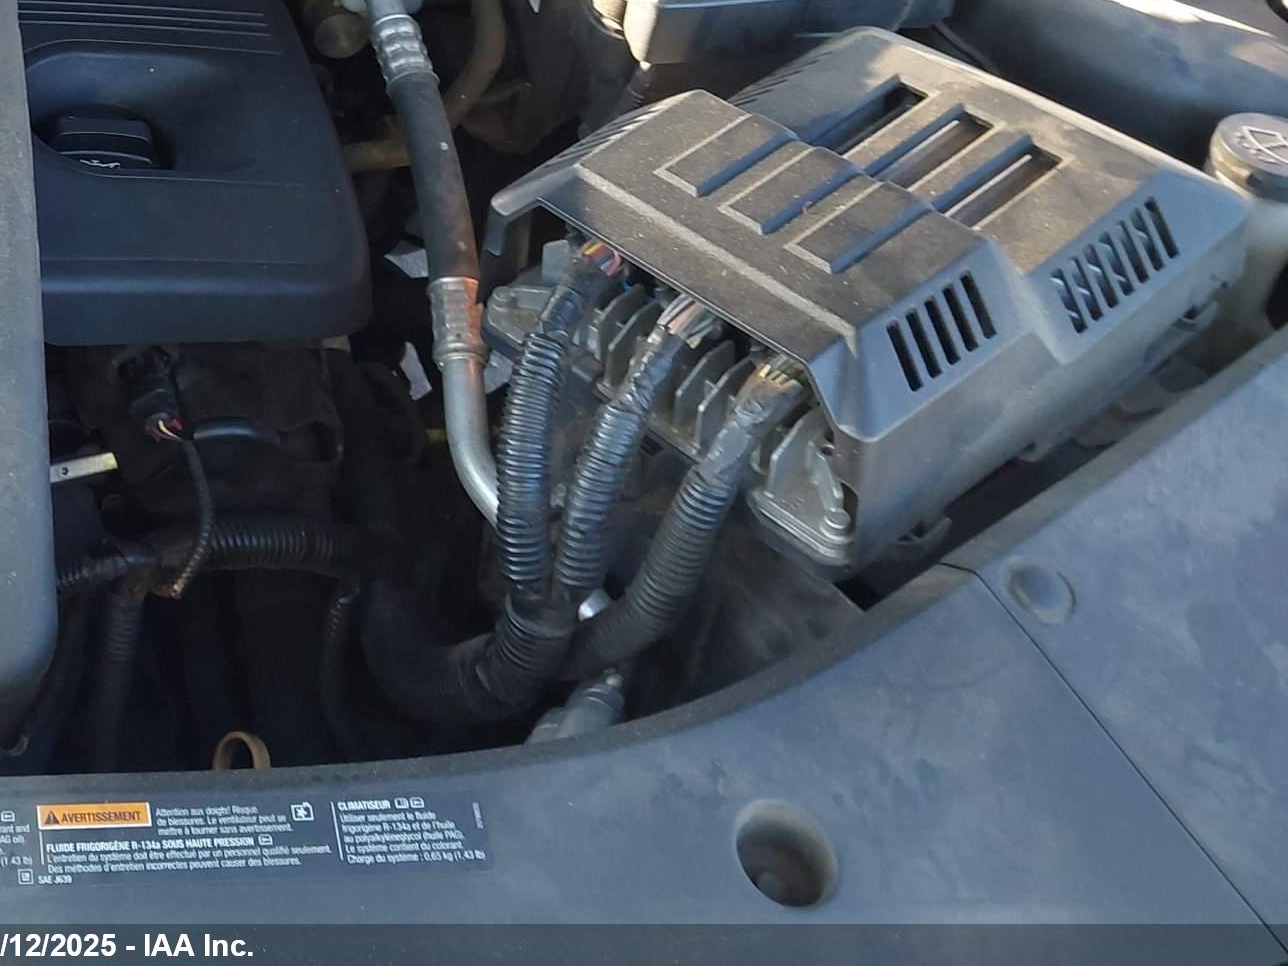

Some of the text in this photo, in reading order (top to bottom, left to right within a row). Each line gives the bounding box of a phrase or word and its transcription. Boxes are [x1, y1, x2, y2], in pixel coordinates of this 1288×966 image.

[337, 799, 391, 811] CLIMATISEUR
[62, 810, 141, 823] AVERTISSEMENT
[156, 817, 167, 827] de
[15, 824, 30, 833] and
[46, 842, 75, 854] FLUIDE
[131, 840, 161, 851] R-134a
[162, 839, 184, 849] SOUS
[185, 838, 212, 848] HAUTE
[214, 836, 254, 848] PRESSION
[88, 852, 99, 862] du
[38, 874, 52, 884] SAE
